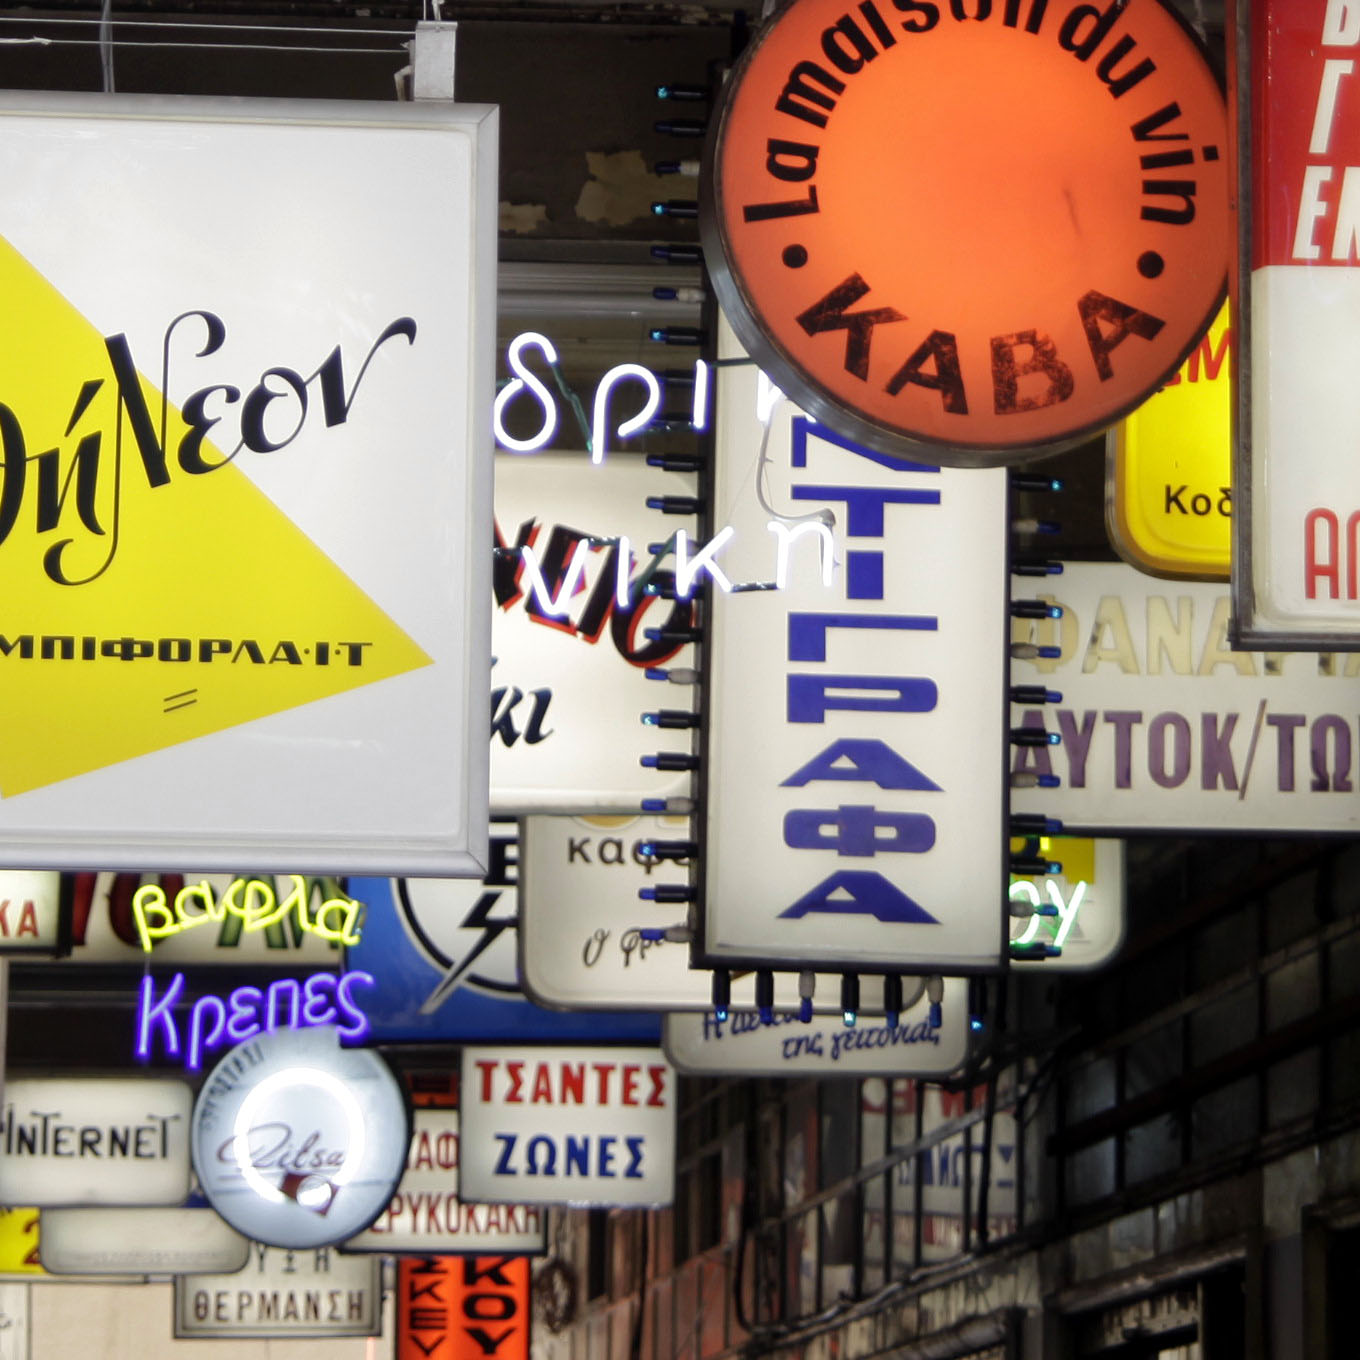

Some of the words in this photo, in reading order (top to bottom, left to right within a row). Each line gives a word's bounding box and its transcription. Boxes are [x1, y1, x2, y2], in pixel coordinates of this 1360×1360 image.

[1129, 101, 1220, 226] vin
[475, 1060, 668, 1108] ΤΣΑΝΤΕΣ
[494, 1133, 646, 1179] ΖΩΝΕΣ
[193, 1289, 364, 1322] ΘΕΡΜΑΝΣΗ
